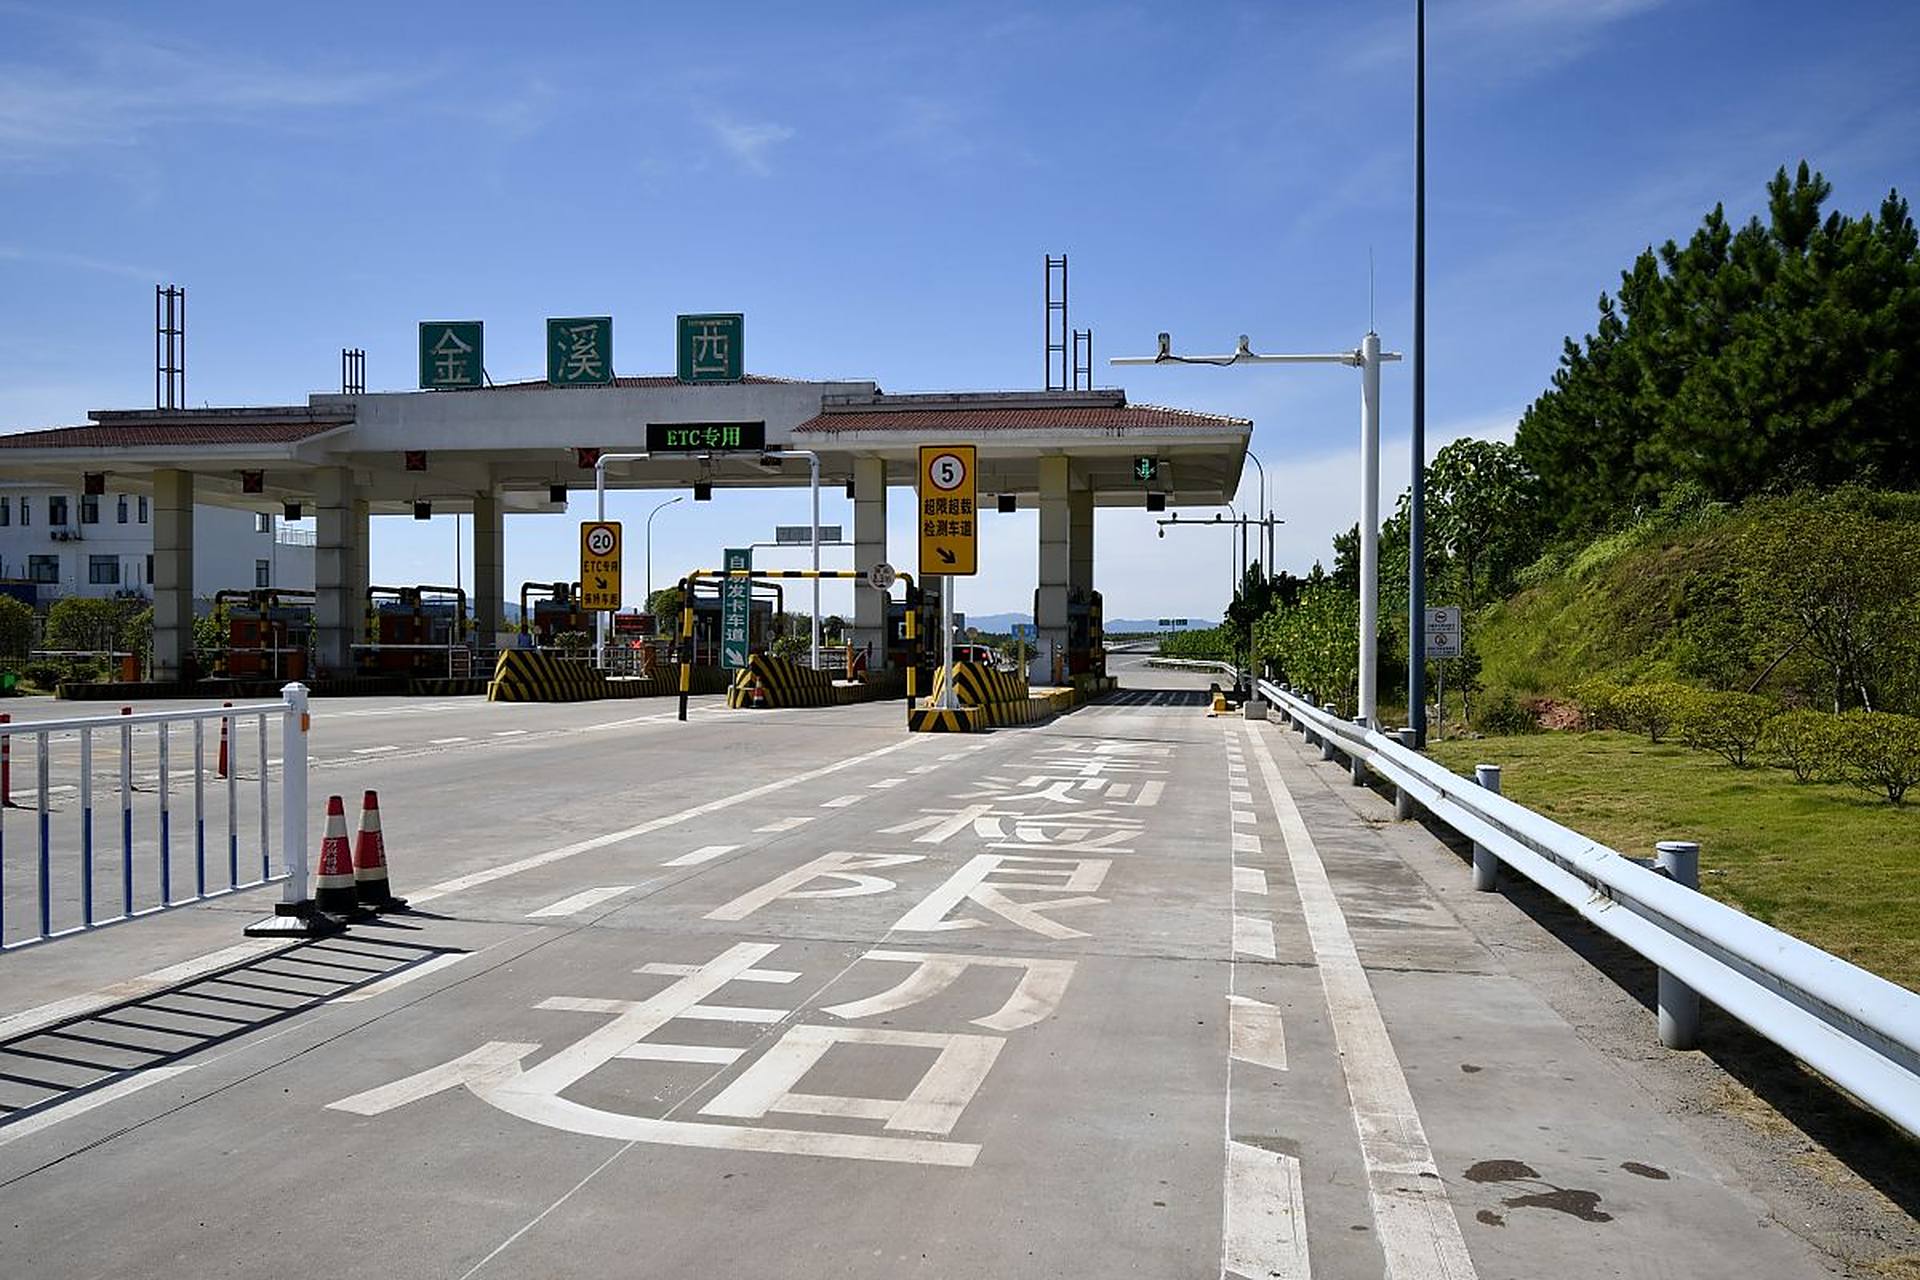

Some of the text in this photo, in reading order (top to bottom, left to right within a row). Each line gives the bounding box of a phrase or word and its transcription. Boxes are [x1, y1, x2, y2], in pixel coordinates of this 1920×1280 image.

[432, 324, 729, 383] 金溪西
[667, 427, 740, 446] ETC专用
[942, 463, 954, 483] 5
[924, 499, 972, 515] 超限超载
[924, 520, 972, 537] 检测车道
[593, 534, 610, 549] 20
